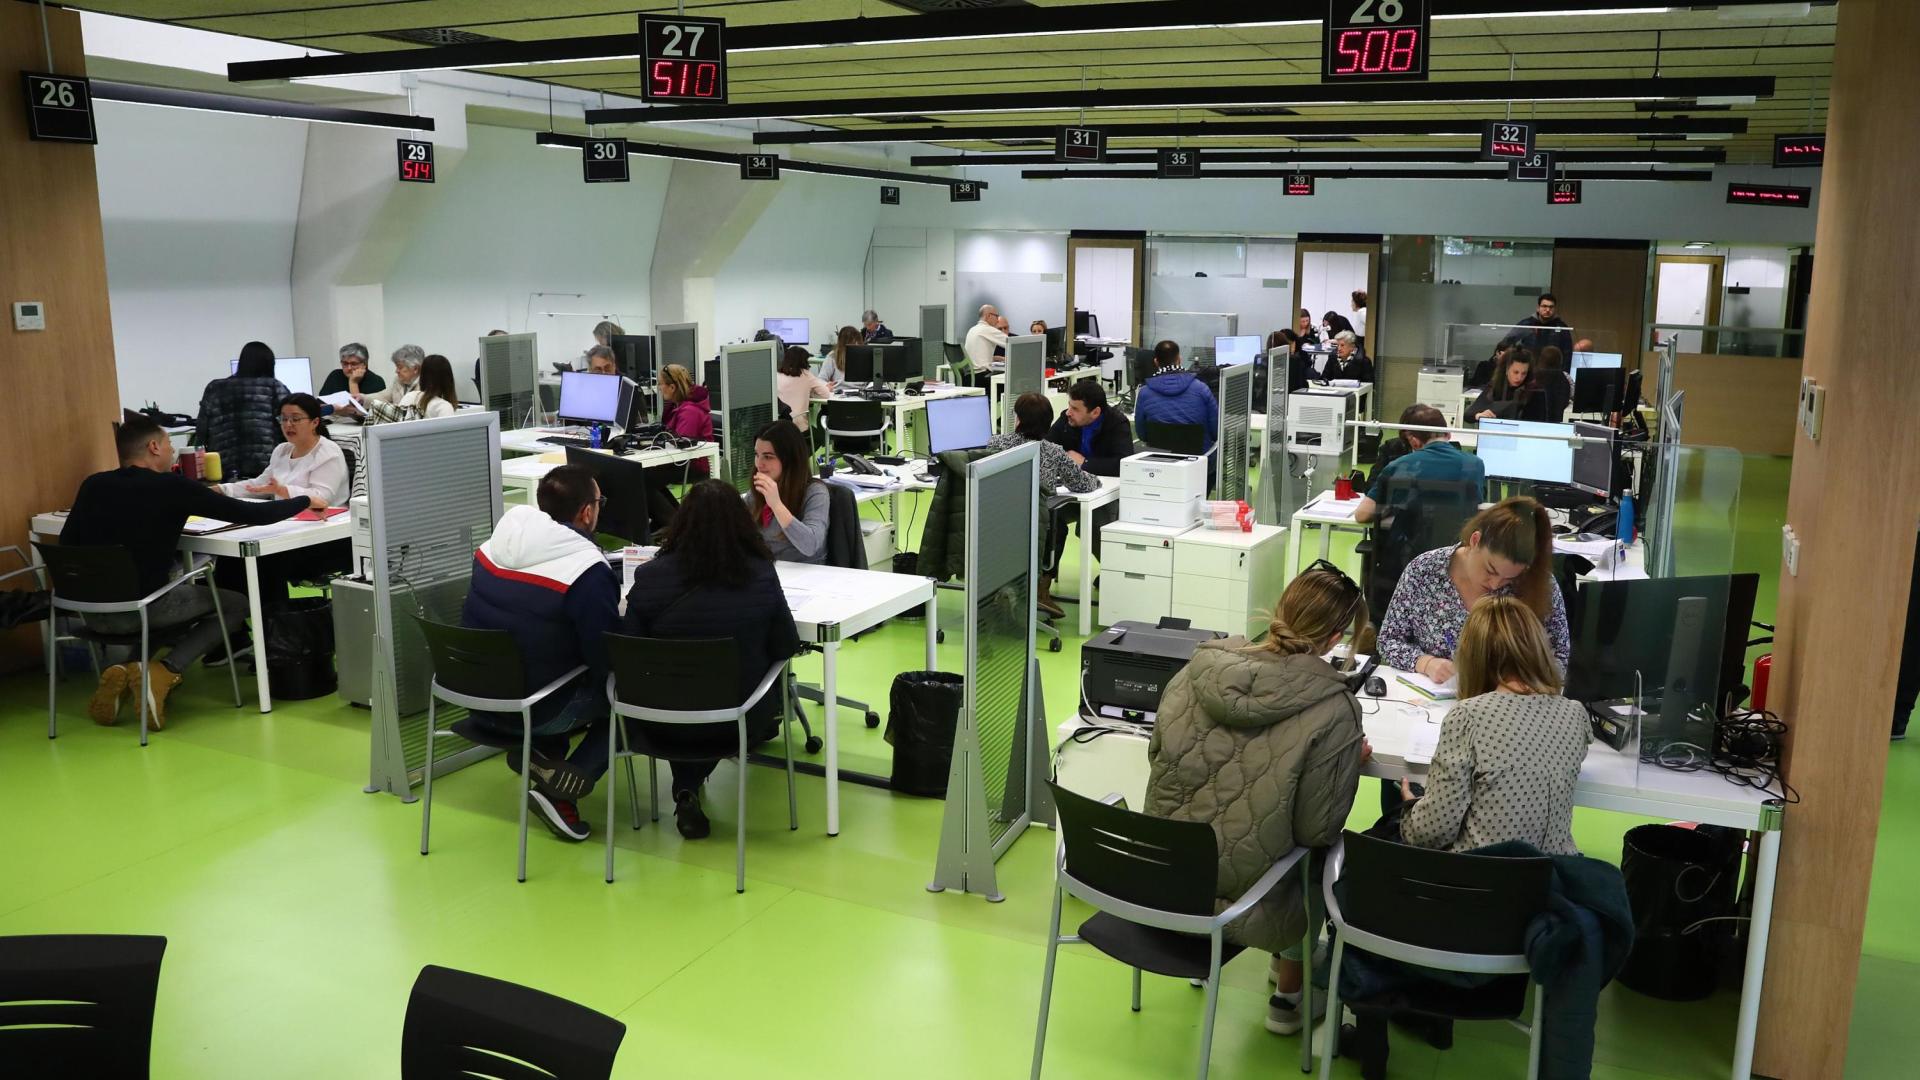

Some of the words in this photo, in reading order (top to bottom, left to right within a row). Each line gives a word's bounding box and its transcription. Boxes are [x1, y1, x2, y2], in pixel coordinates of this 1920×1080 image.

[1349, 0, 1403, 23] 28
[662, 25, 705, 57] 27
[1336, 29, 1416, 73] 508
[653, 61, 716, 96] 510
[40, 80, 75, 107] 26
[1073, 131, 1090, 145] 31
[1500, 126, 1519, 142] 32
[408, 145, 426, 160] 29
[593, 143, 617, 159] 30
[1171, 153, 1187, 165] 35
[403, 161, 429, 178] 514
[752, 157, 767, 168] 34
[959, 184, 971, 192] 38
[1294, 176, 1306, 185] 39
[1558, 183, 1571, 193] 40
